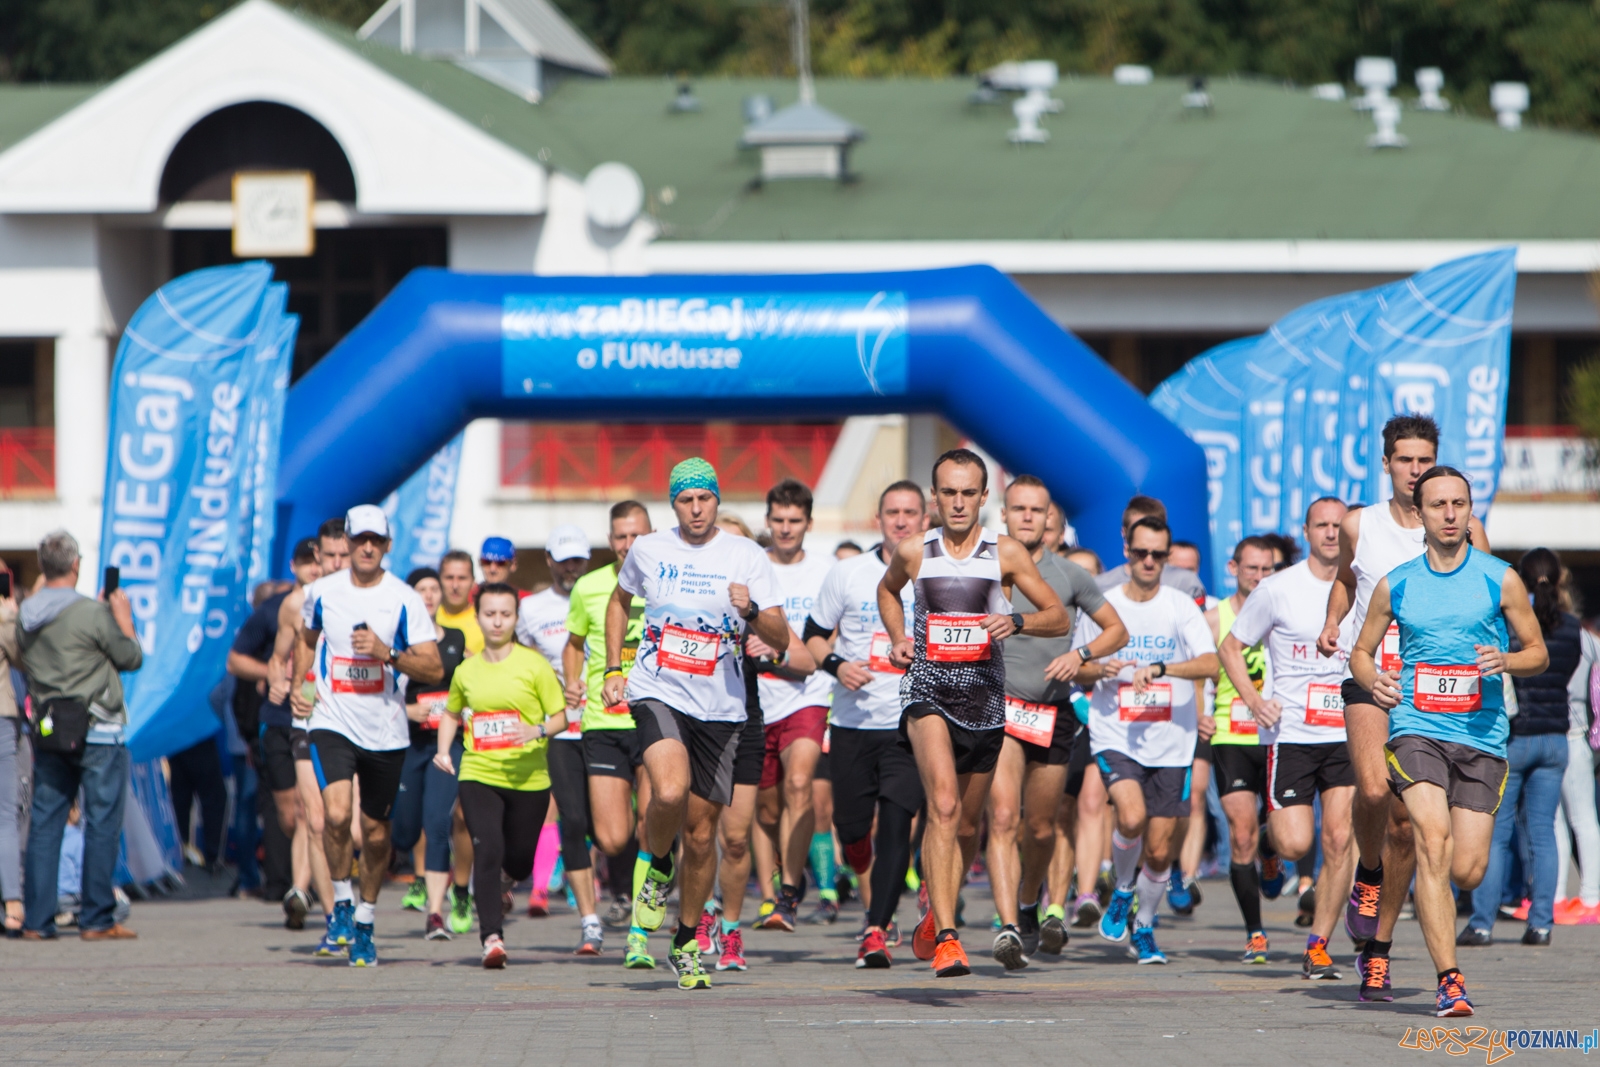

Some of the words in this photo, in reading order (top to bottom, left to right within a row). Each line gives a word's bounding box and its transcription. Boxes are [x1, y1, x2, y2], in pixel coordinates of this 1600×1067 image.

[577, 298, 745, 341] zaBIEGaj
[576, 348, 598, 369] o
[602, 341, 743, 369] FUNdusze
[1463, 364, 1500, 520] dusze
[681, 579, 711, 587] PHILIPS
[698, 588, 716, 596] 2016
[944, 628, 972, 643] 377
[1126, 635, 1176, 650] BIEGaj
[680, 640, 699, 656] 32
[345, 665, 369, 681] 430
[1438, 678, 1458, 693] 87
[1134, 692, 1157, 706] 824
[1013, 709, 1039, 727] 552
[483, 719, 506, 736] 247
